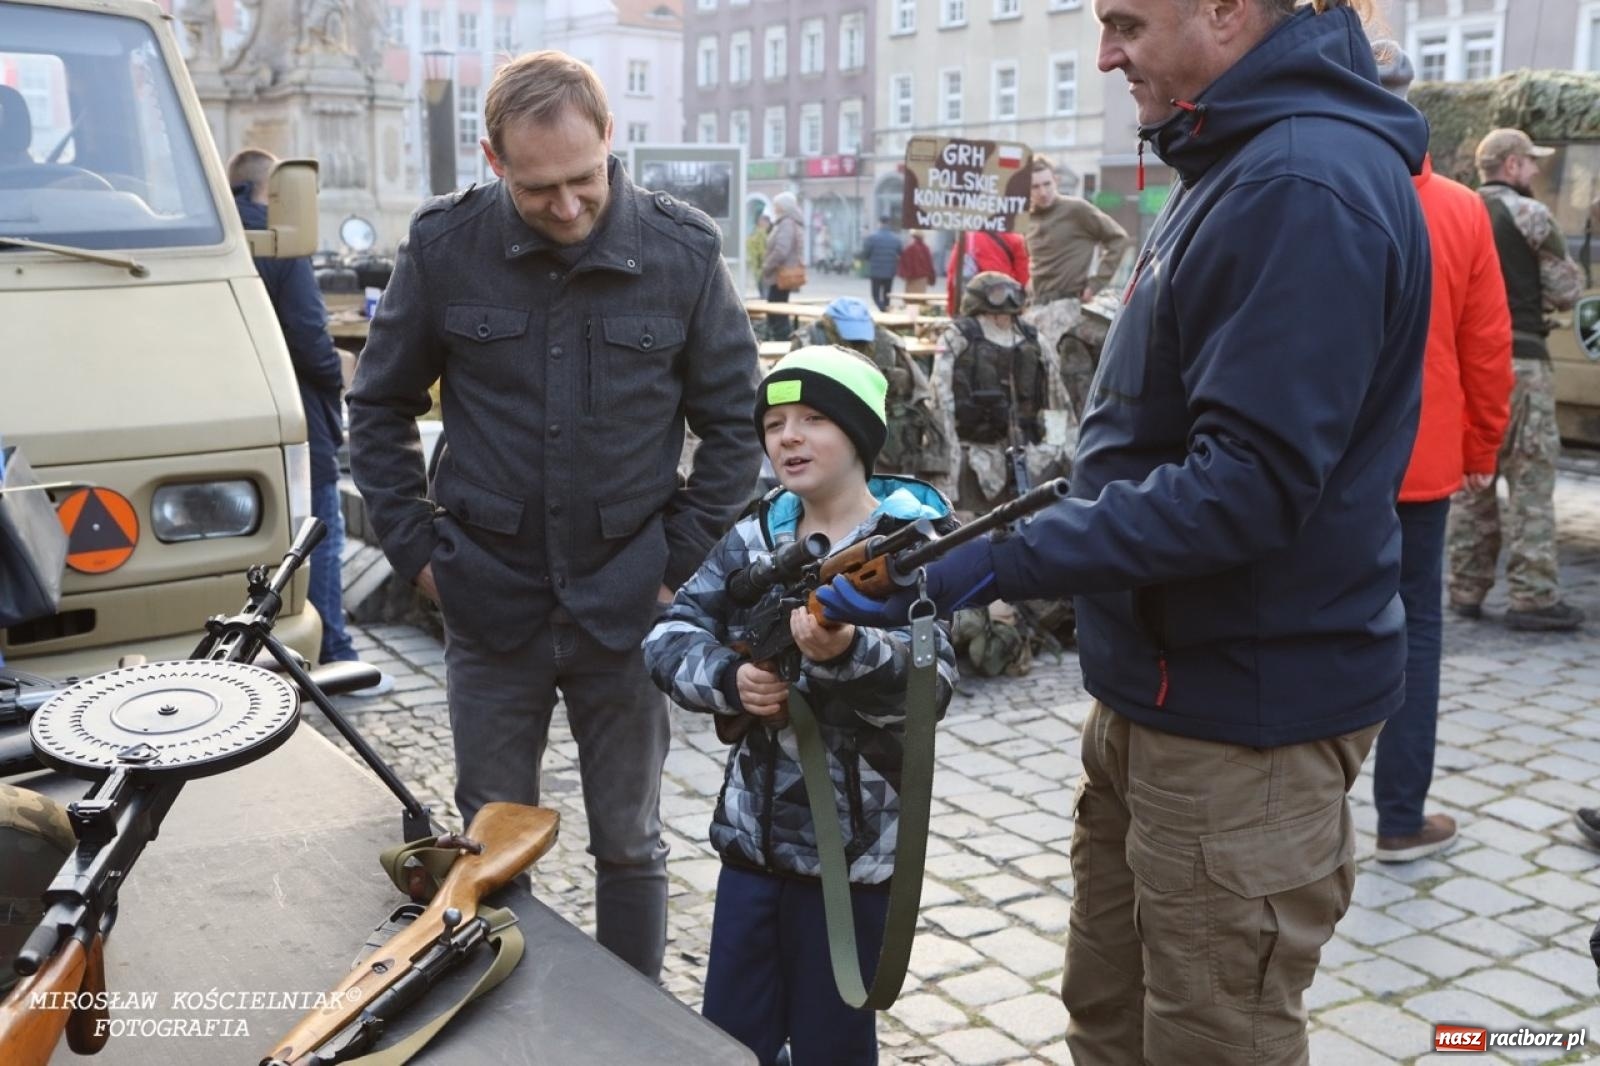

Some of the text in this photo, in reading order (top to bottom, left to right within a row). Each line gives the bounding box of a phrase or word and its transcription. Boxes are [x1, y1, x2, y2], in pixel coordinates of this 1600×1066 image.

[943, 144, 985, 167] GRH
[928, 168, 999, 194] POLSKIE
[914, 188, 1027, 214] KONTYNGENTY
[916, 211, 1006, 231] WOJSKOWE
